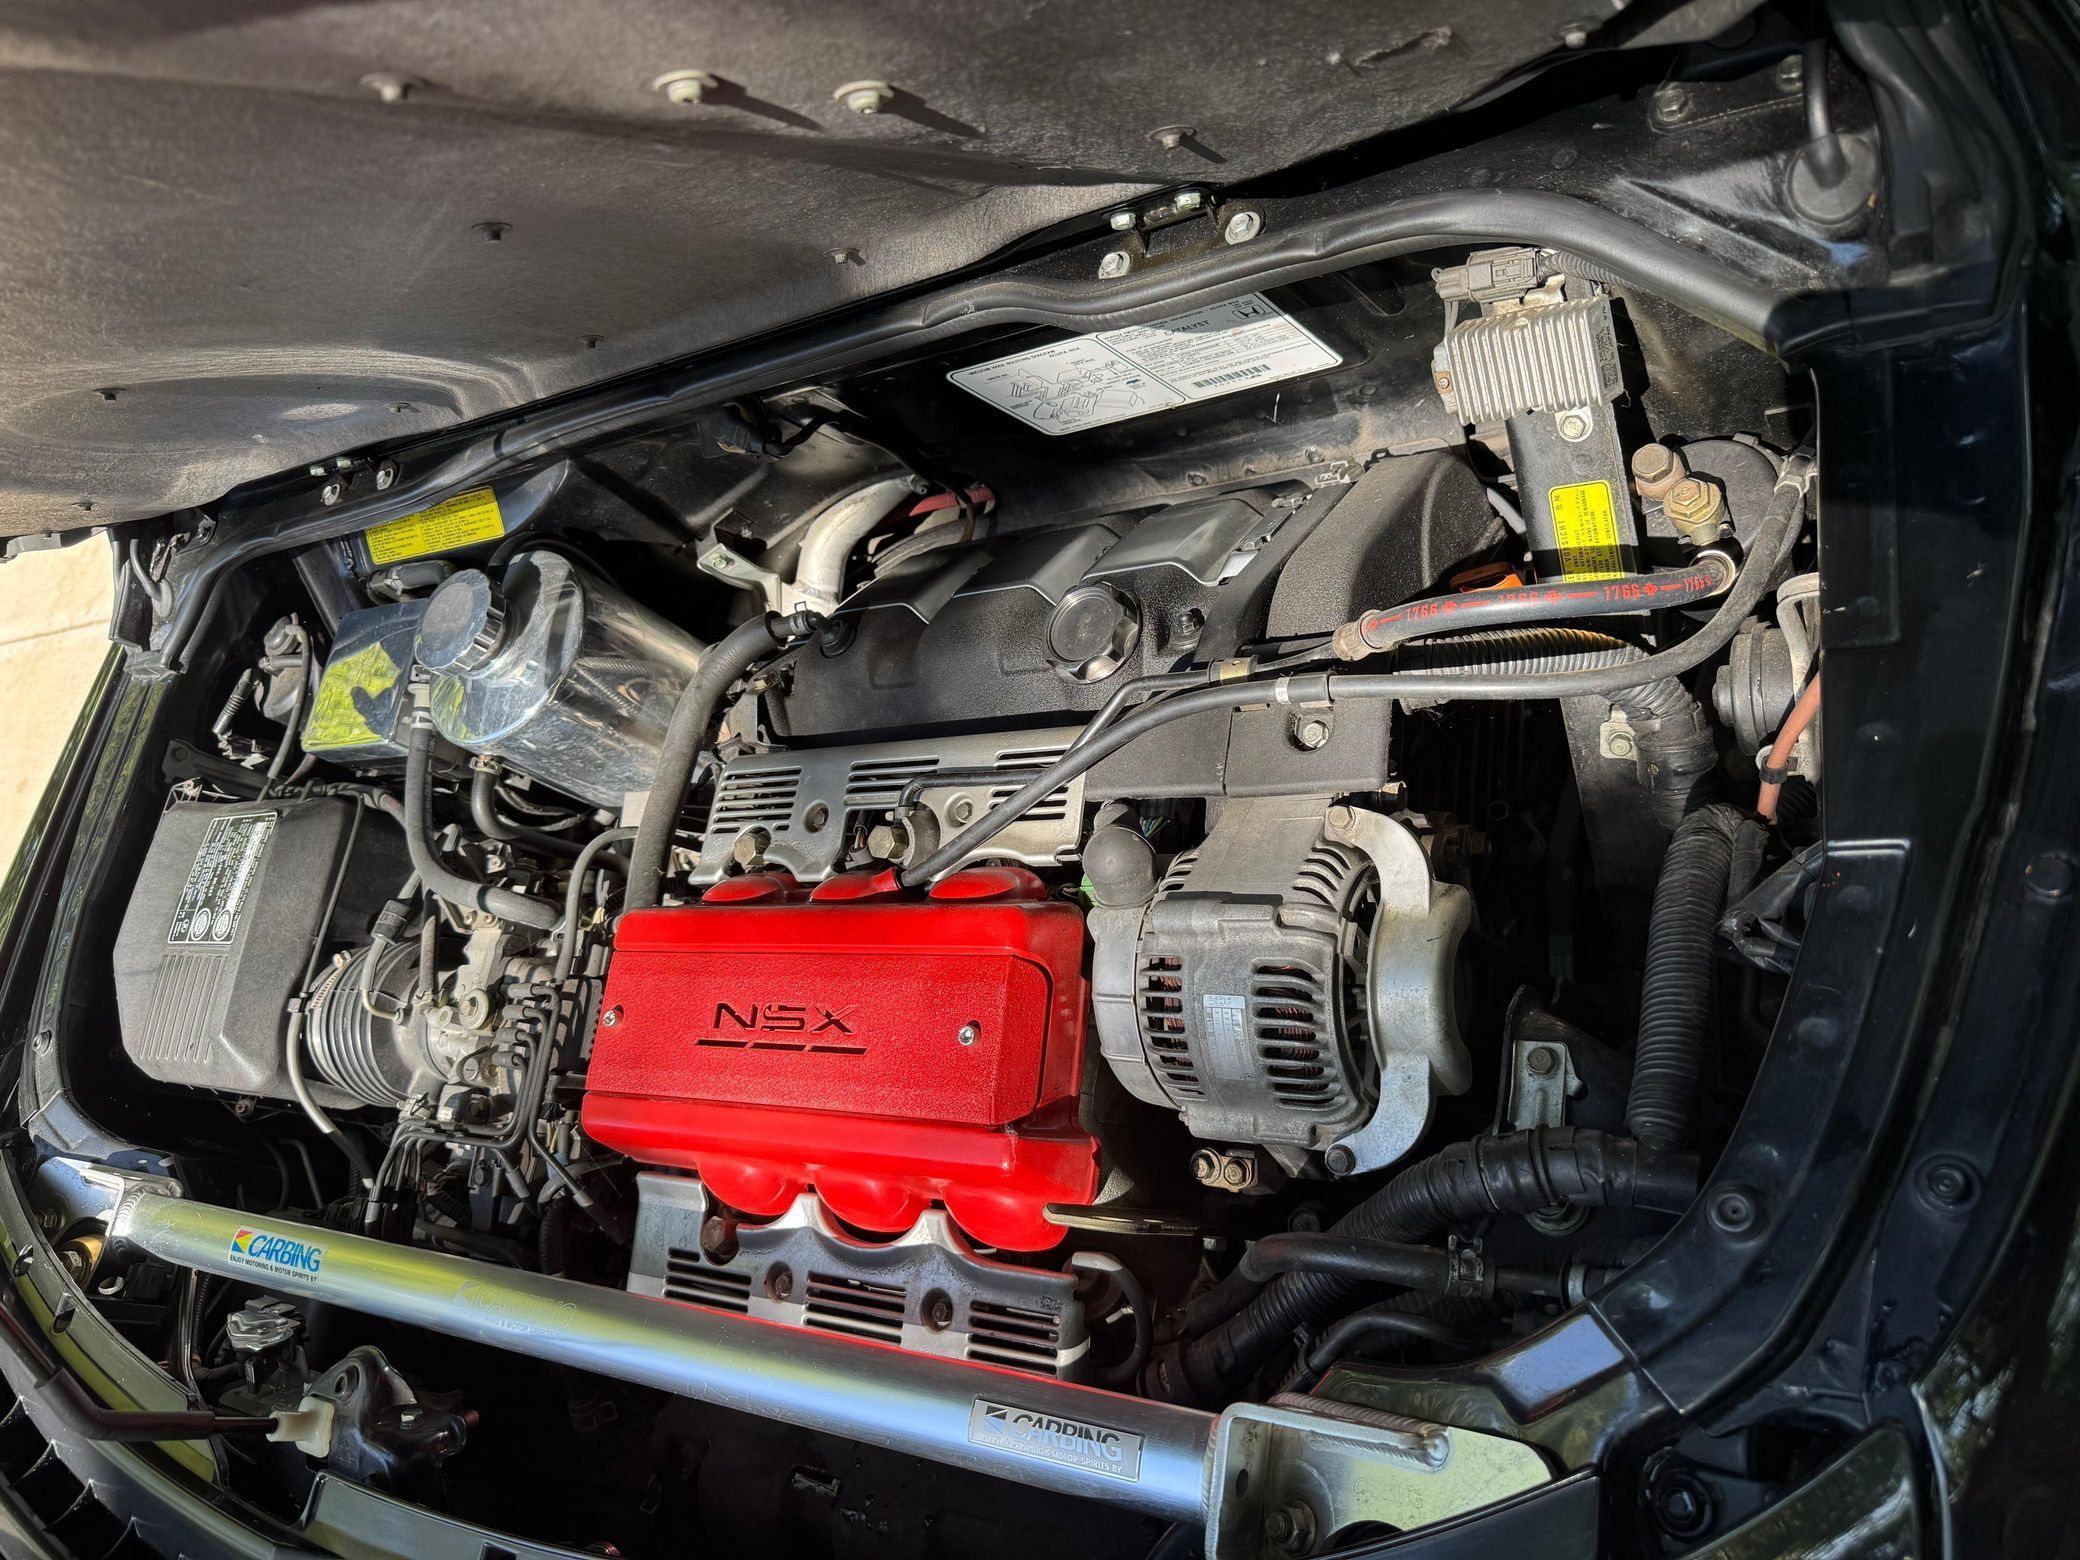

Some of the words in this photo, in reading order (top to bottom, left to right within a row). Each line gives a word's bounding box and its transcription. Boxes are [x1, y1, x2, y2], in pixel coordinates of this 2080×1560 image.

[1164, 319, 1211, 338] CATALYST
[1558, 519, 1572, 562] VORSICHT
[1406, 603, 1438, 623] 1766
[1603, 583, 1641, 602] 1766
[712, 1001, 858, 1035] NSX
[230, 1254, 245, 1264] ENJOY
[245, 1258, 269, 1272] MOTORING
[274, 1266, 292, 1277] MOTOR
[292, 1270, 310, 1282] SPIRITS
[310, 1275, 318, 1283] BY
[247, 1234, 322, 1273] CARBING
[1010, 1413, 1122, 1462] CARBING
[1051, 1450, 1078, 1464] MOTOR
[1080, 1457, 1110, 1472] SPIRITS
[1112, 1464, 1122, 1474] BY
